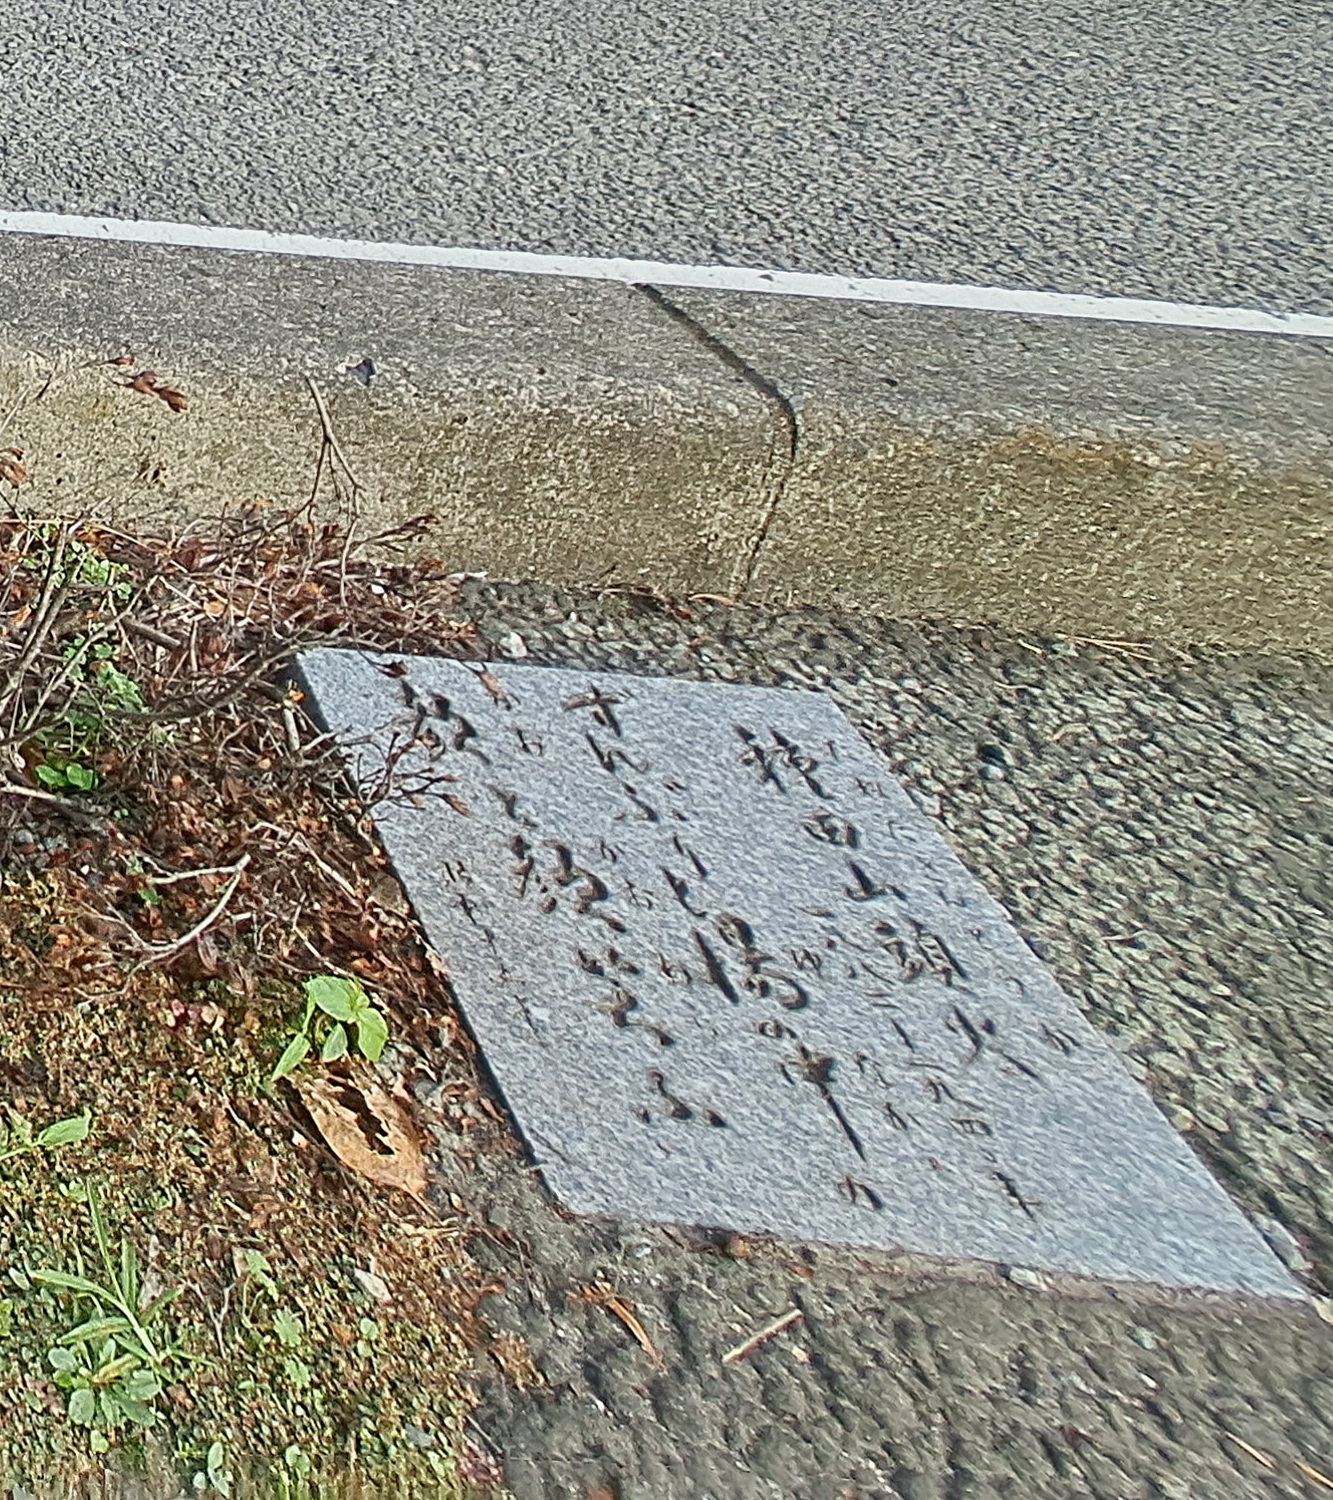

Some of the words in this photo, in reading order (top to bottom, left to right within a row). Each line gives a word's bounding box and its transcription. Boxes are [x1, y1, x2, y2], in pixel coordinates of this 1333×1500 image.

[726, 723, 1026, 1076] 種田山頭火
